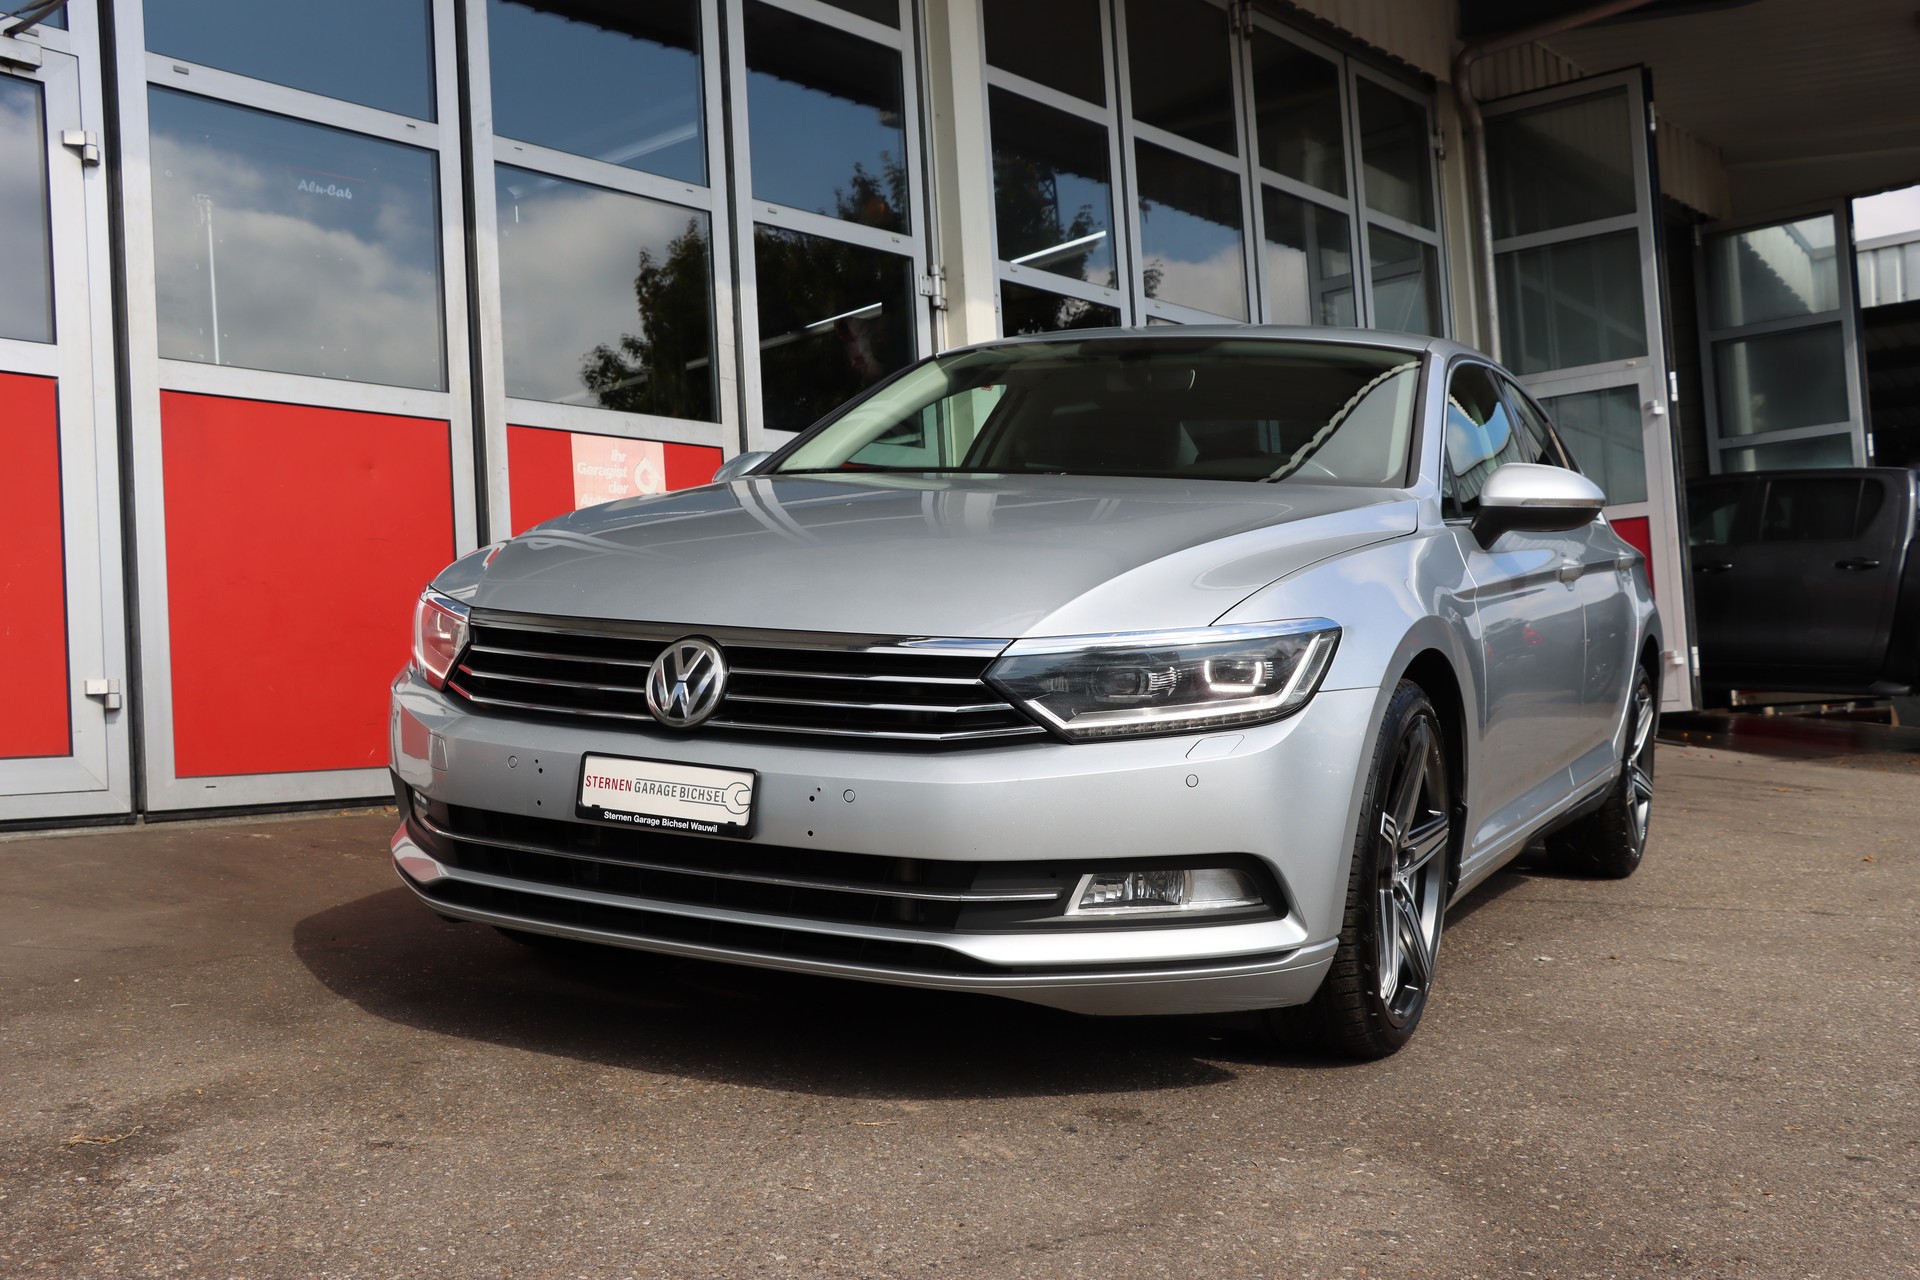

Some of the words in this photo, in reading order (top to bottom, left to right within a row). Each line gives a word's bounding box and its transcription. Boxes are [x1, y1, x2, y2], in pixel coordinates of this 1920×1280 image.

[610, 448, 627, 462] Ihr
[577, 462, 627, 479] Garagist
[608, 482, 628, 494] der
[648, 641, 722, 725] VW
[585, 775, 632, 792] STERNEN
[634, 781, 677, 797] GARAGE
[679, 786, 726, 803] BICHSEL
[603, 811, 632, 822] Sternen
[633, 815, 660, 826] Garage
[661, 819, 689, 829] Bichsel
[690, 822, 718, 833] Wauwil
